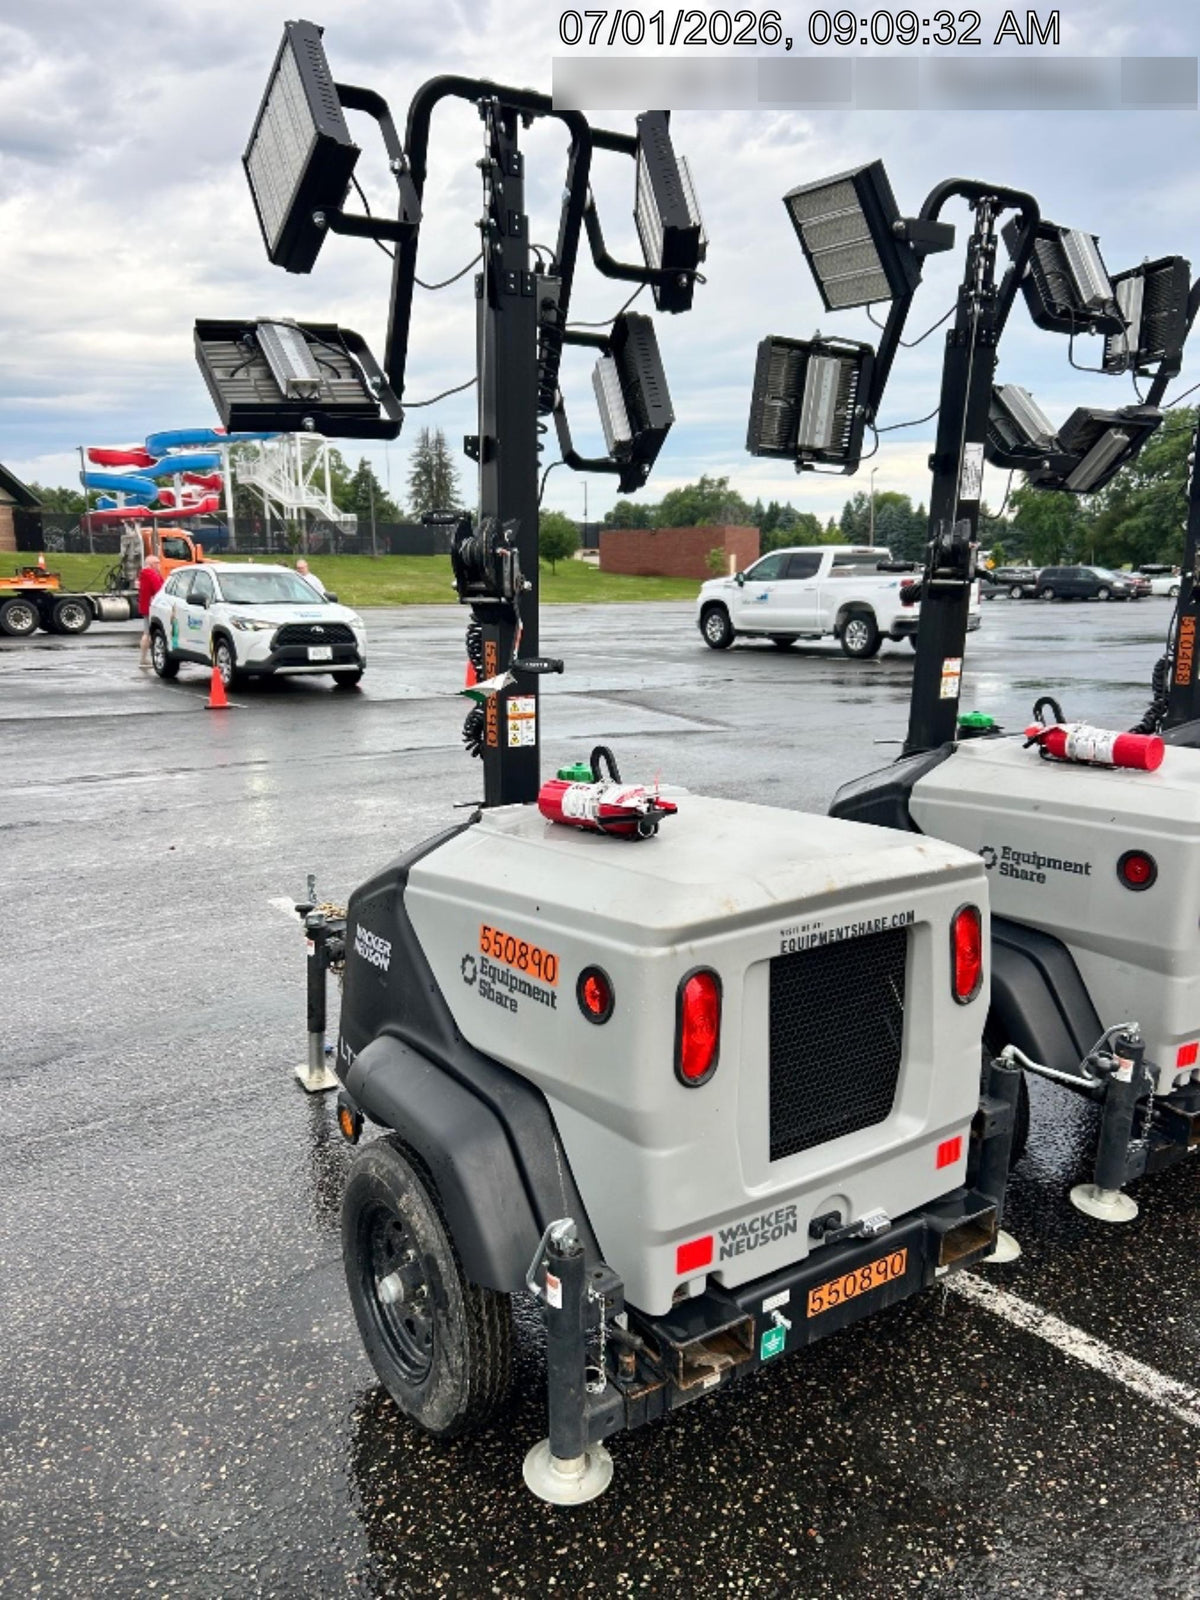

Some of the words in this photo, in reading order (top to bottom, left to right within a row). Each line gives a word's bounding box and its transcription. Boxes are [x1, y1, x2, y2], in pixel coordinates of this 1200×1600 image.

[486, 643, 498, 744] 55890
[1000, 862, 1046, 884] Share
[1001, 846, 1093, 876] Equipment
[780, 910, 915, 954] EQUIPMENTSHARE.COM
[481, 925, 556, 983] 550890
[479, 977, 518, 1013] Share
[480, 956, 558, 1010] Equipment
[718, 1204, 798, 1244] WACKER
[719, 1219, 798, 1261] NEUSON
[810, 1252, 905, 1313] 550890
